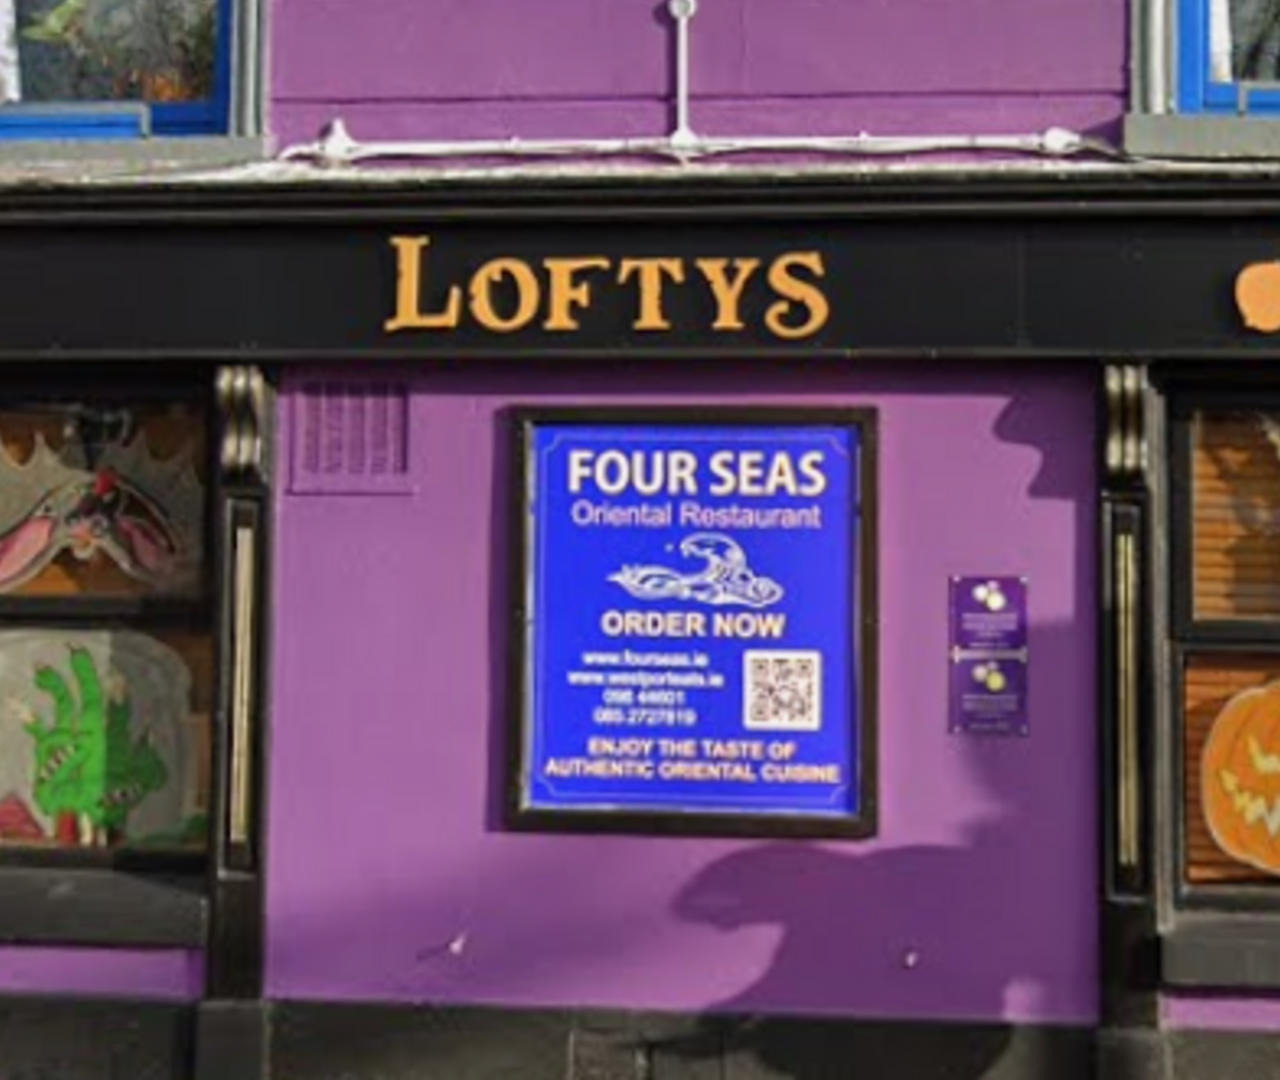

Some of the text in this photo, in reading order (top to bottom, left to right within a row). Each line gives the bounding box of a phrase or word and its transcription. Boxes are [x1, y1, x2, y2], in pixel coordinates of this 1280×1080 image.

[384, 234, 830, 339] LOFTYS
[568, 449, 828, 497] FOUR SEAS
[571, 500, 823, 530] Oriental Restaurant
[601, 610, 787, 639] ORDER NOW
[588, 736, 797, 760] ENJOY THE TASTE OF
[544, 756, 842, 785] AUTHENTIC ORIENTAL CUISINE
